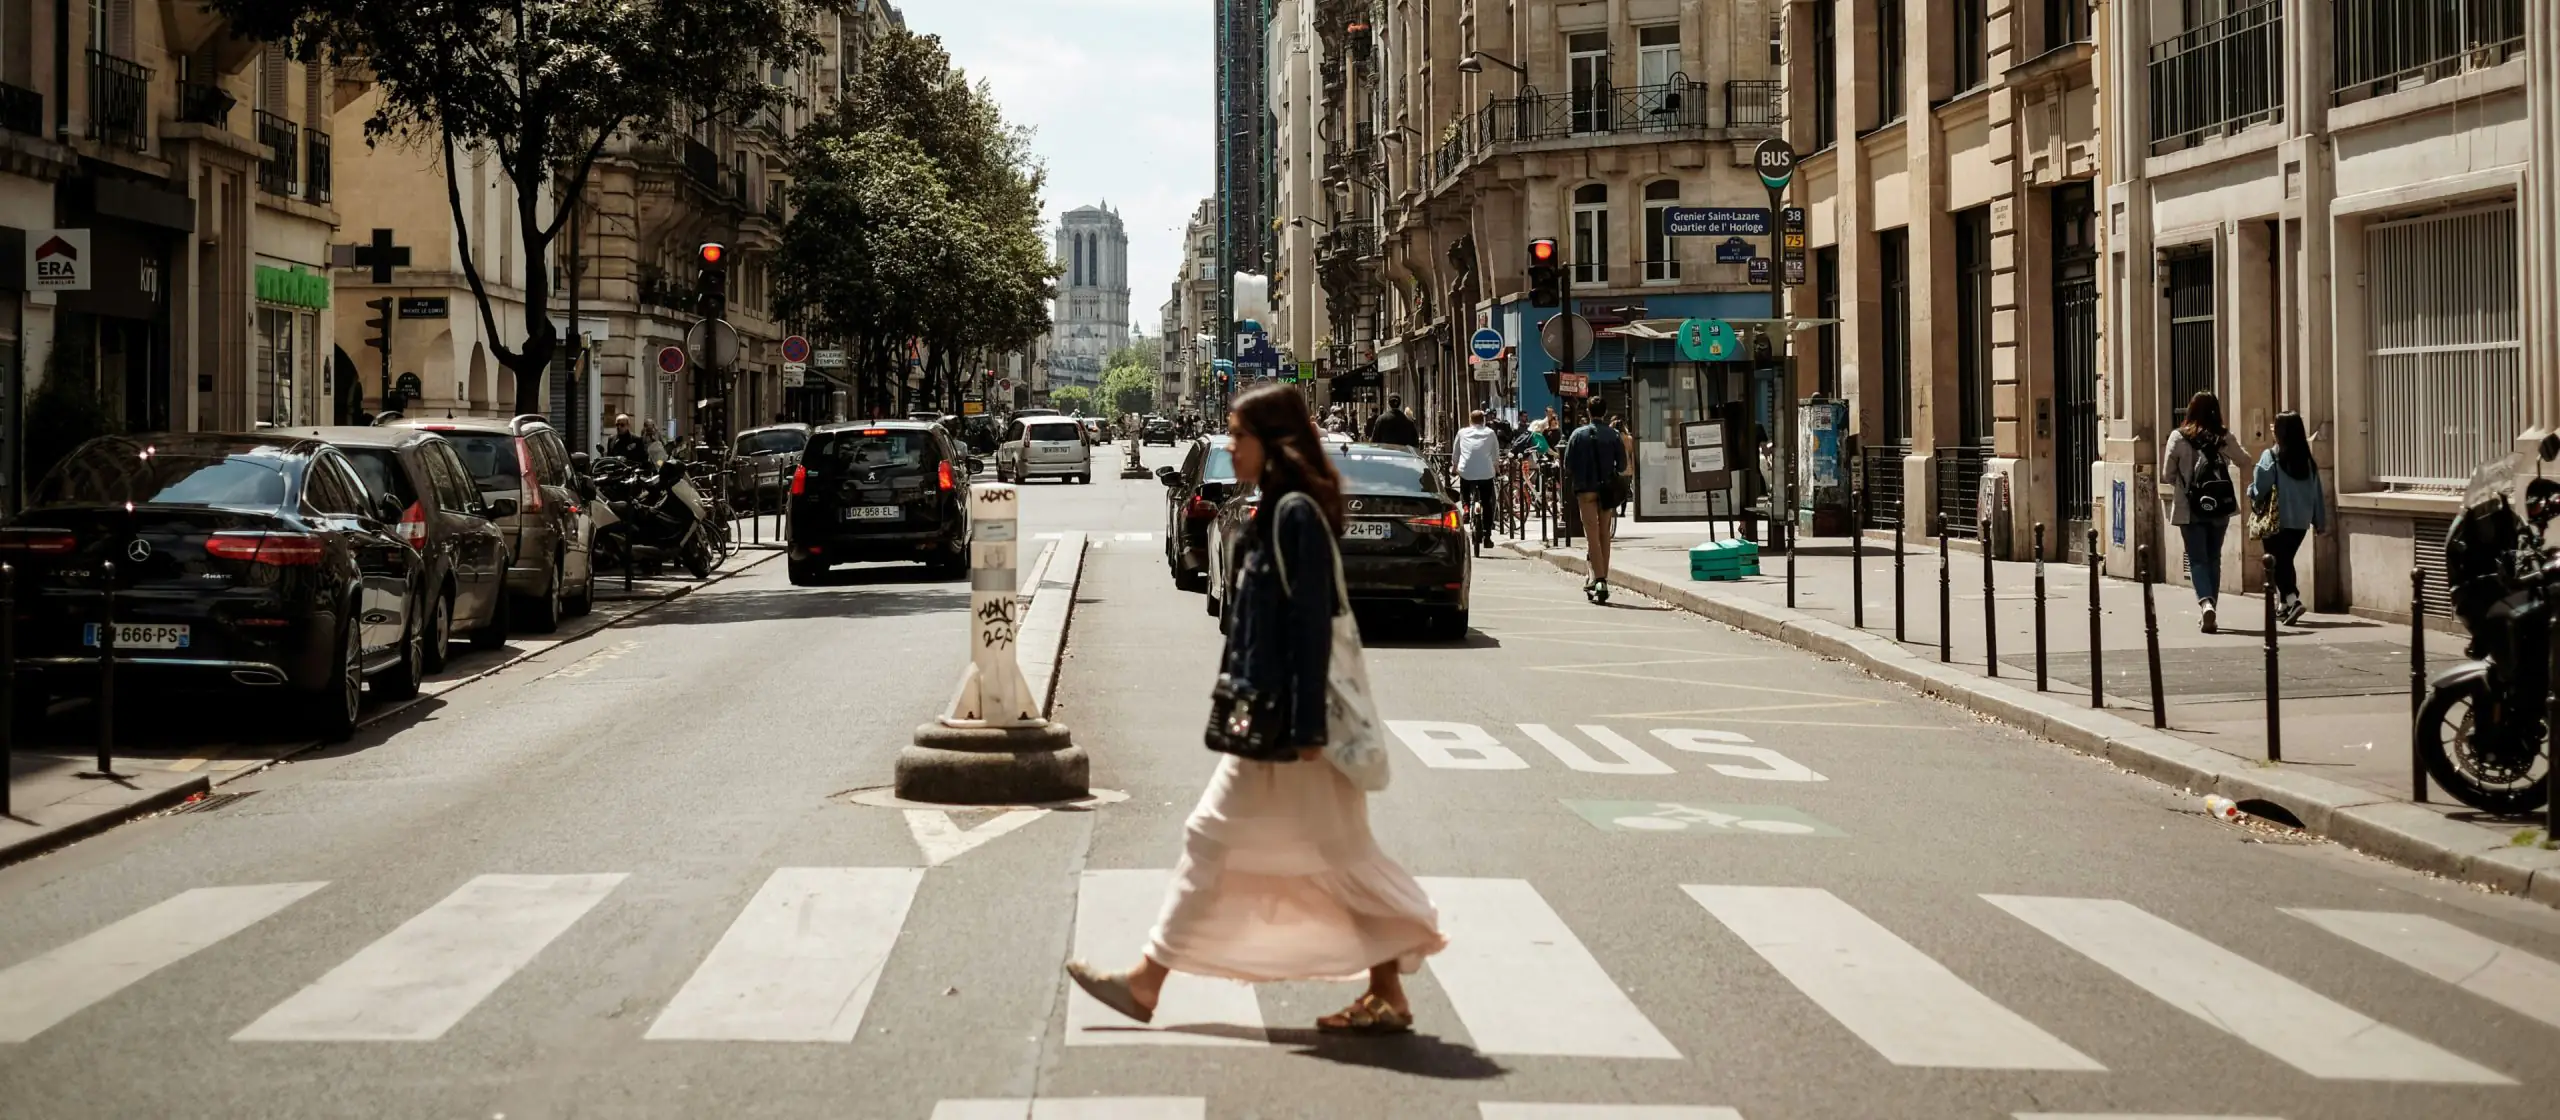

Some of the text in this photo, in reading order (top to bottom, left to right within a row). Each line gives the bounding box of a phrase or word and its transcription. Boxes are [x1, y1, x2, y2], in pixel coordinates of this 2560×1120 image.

[1761, 150, 1790, 167] BUS
[1673, 212, 1760, 221] Grenier Saint-Lazare
[1787, 210, 1802, 222] 38
[1670, 223, 1707, 233] Quartier
[1708, 223, 1720, 232] de
[1729, 223, 1764, 234] Horloge
[1787, 235, 1801, 246] 75
[37, 261, 75, 275] ERA
[1237, 333, 1256, 357] P
[852, 508, 893, 517] DZ-958-EL
[1384, 720, 1829, 782] BUS
